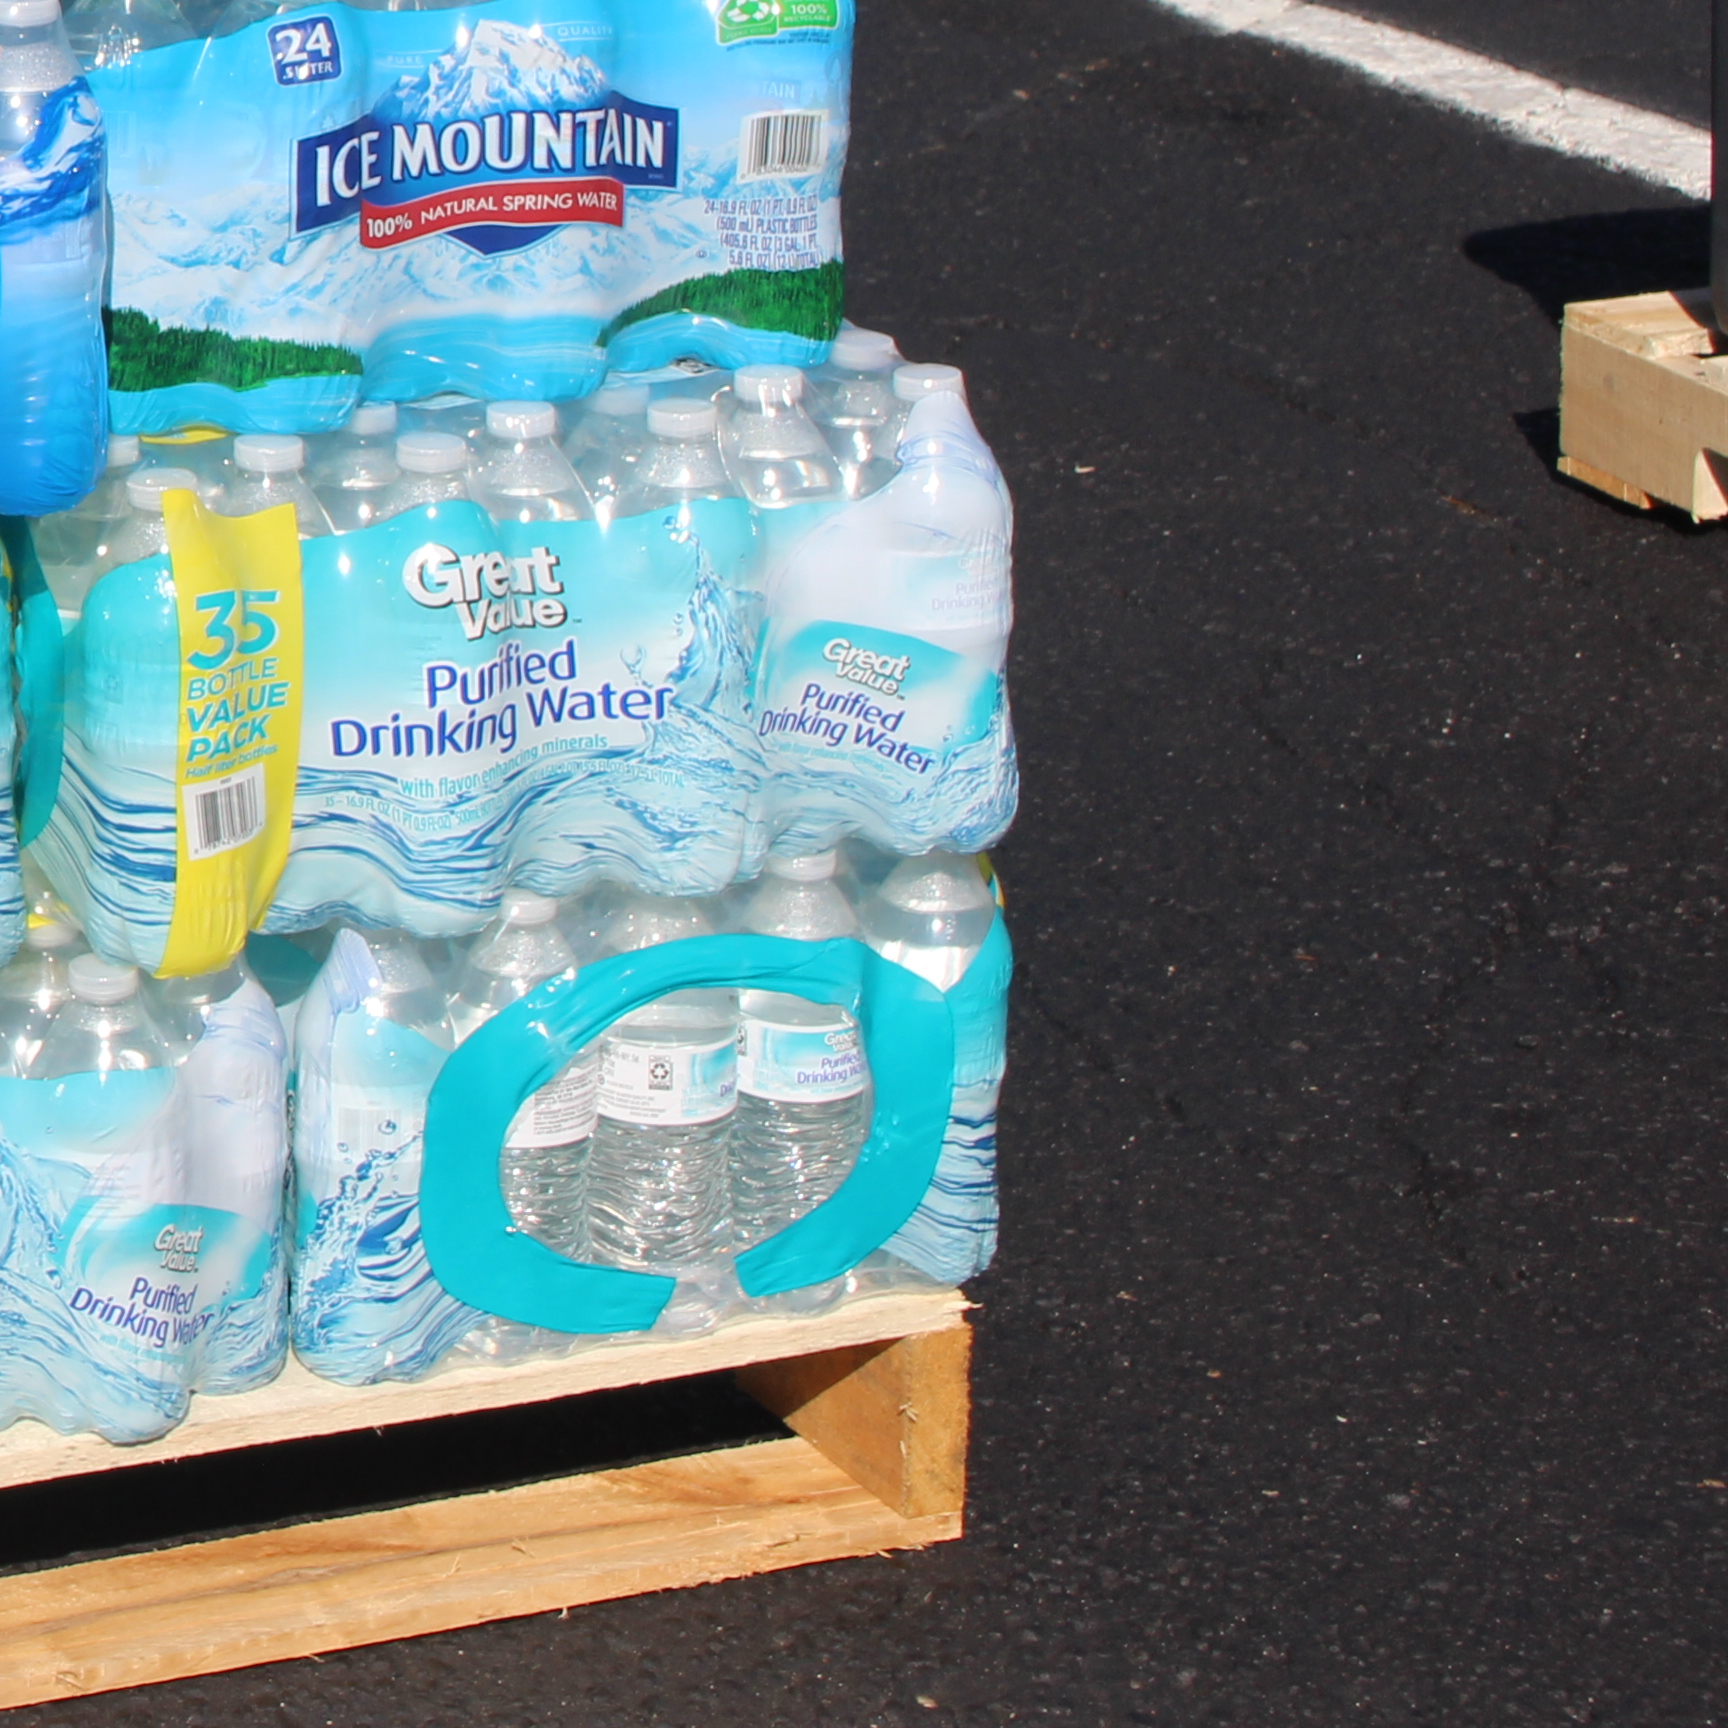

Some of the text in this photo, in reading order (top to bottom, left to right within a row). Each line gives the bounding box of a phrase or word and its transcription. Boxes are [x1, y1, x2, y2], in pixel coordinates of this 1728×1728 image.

[557, 25, 612, 37] QUALITY
[790, 4, 827, 15] 100%
[274, 22, 332, 64] 24
[315, 111, 664, 207] ICE MOUNTAIN
[367, 191, 618, 239] 100% NATURAL SPRING WATER
[403, 543, 563, 609] Great
[187, 589, 280, 670] 35
[454, 594, 566, 642] Value
[187, 657, 278, 701] BOTTLE
[424, 638, 579, 710] Purified
[823, 637, 911, 681] Great
[836, 660, 899, 696] Value
[186, 680, 291, 732] VALUE
[330, 682, 675, 759] Drinking Water
[800, 682, 906, 733] Purified
[185, 713, 271, 763] PACK
[185, 742, 279, 779] Half bottles
[758, 706, 937, 774] Drinking Water
[399, 732, 609, 800] with flavor enhancing minerals
[797, 1066, 848, 1084] Drinking
[155, 1223, 204, 1254] Great
[161, 1249, 195, 1273] Value
[69, 1286, 216, 1349] Drinking Water
[129, 1276, 199, 1315] Purified
